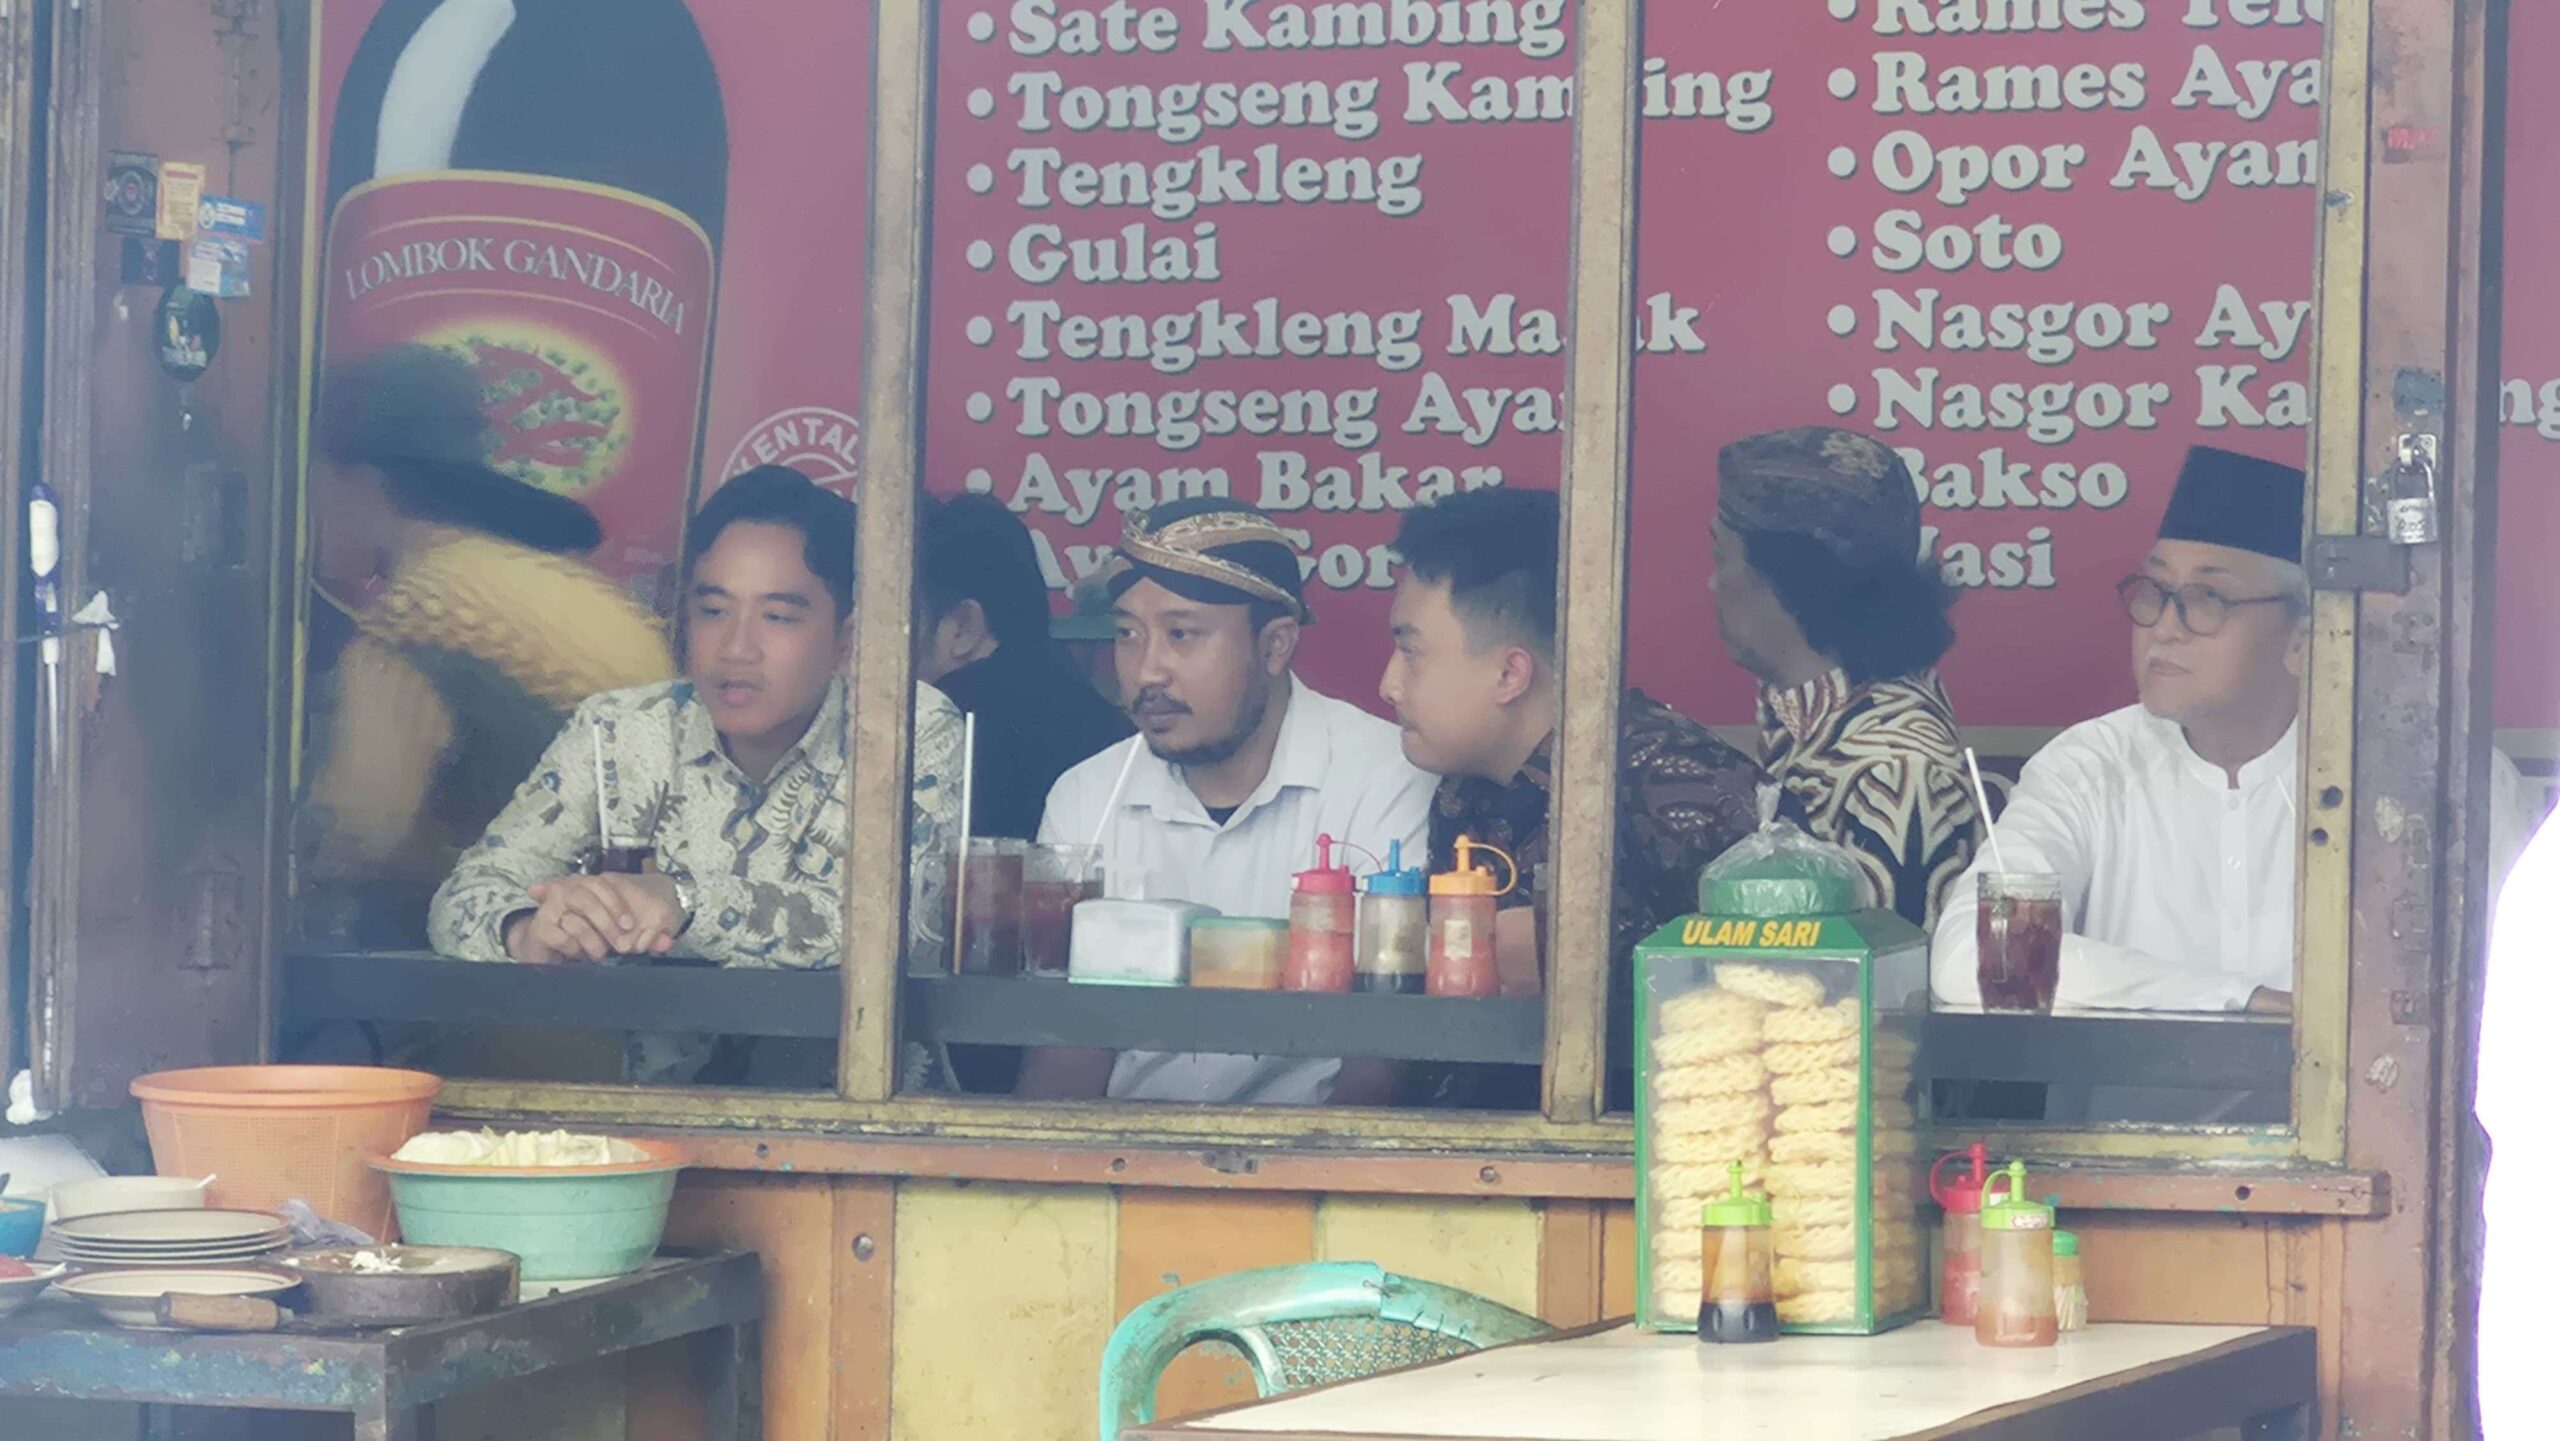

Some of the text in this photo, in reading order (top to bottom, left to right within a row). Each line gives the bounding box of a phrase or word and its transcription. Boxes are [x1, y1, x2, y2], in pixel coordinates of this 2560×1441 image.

[1008, 0, 1566, 57] Sate Kambing
[1008, 58, 1773, 143] Tongseng Kaming
[1872, 52, 2147, 112] Rames
[1007, 145, 1423, 216] Tengkleng
[1873, 130, 2086, 202] Opor
[1008, 222, 1221, 283] Gulai
[1872, 210, 2062, 270] Soto
[345, 237, 686, 335] LOMBOK GANDARIA
[1006, 291, 1706, 371] Tengkleng Mak
[1872, 288, 2170, 363] Nasgor
[1007, 376, 1379, 449] Tongseng
[1872, 367, 2170, 443] Nasgor
[1007, 453, 1230, 524] Ayam
[1682, 920, 1821, 946] ULAM SARI
